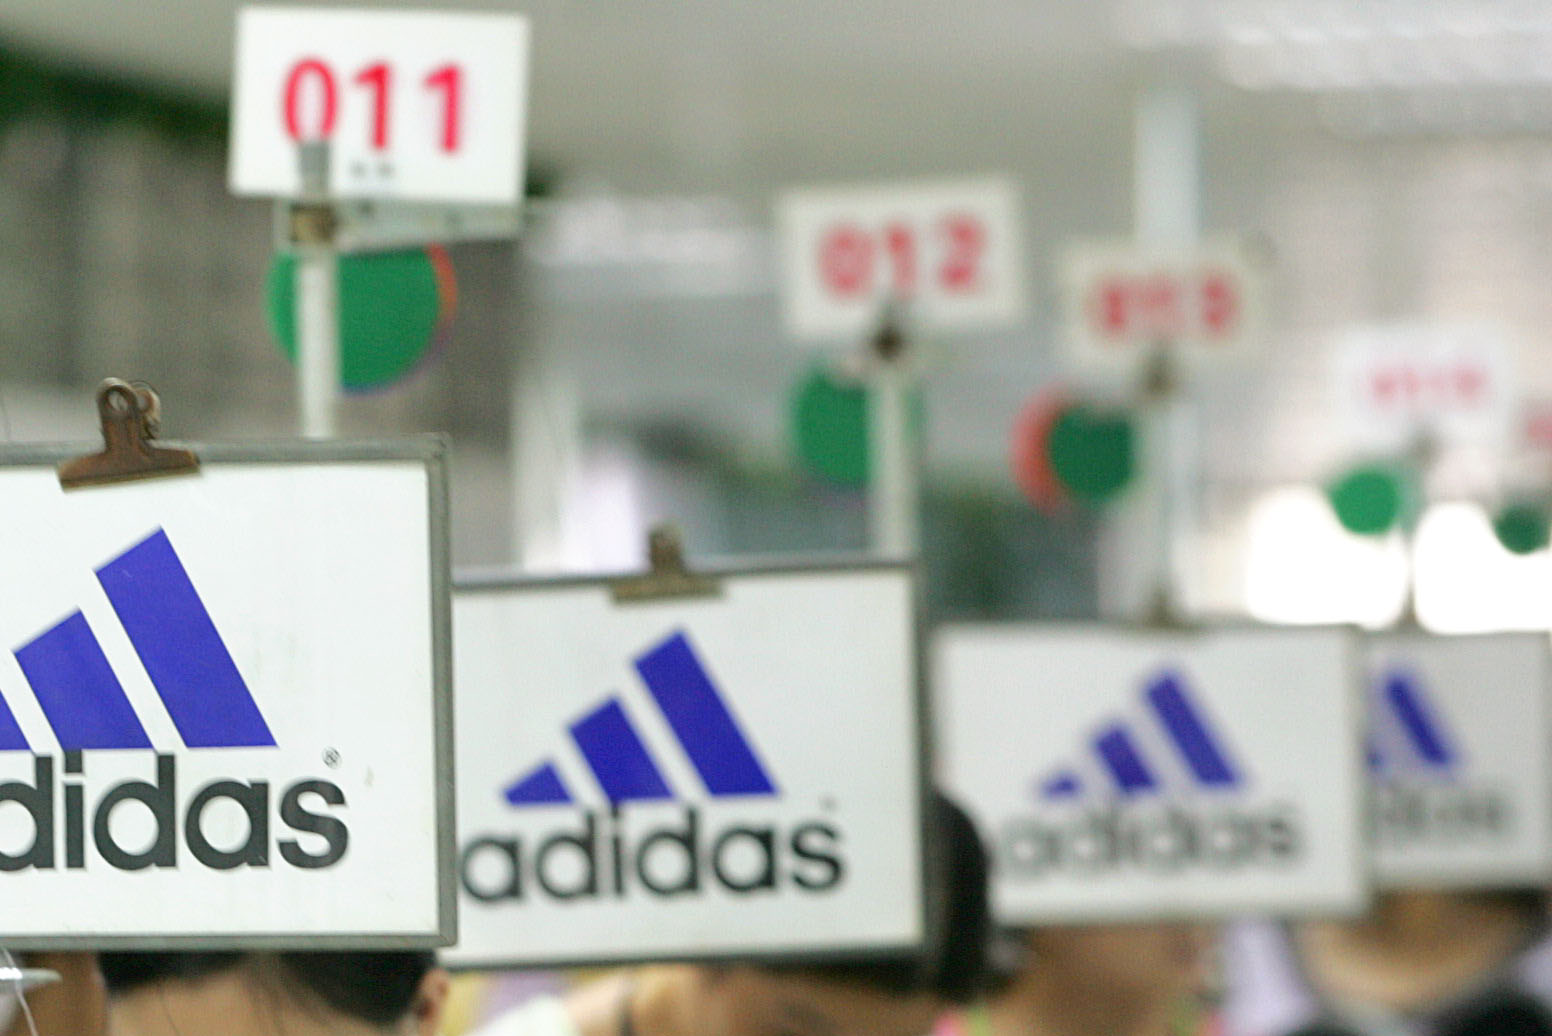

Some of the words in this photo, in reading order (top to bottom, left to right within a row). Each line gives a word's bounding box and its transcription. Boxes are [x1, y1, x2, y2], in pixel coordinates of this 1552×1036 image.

[281, 54, 462, 155] 011
[814, 211, 991, 304] 012
[460, 802, 846, 903] adidas
